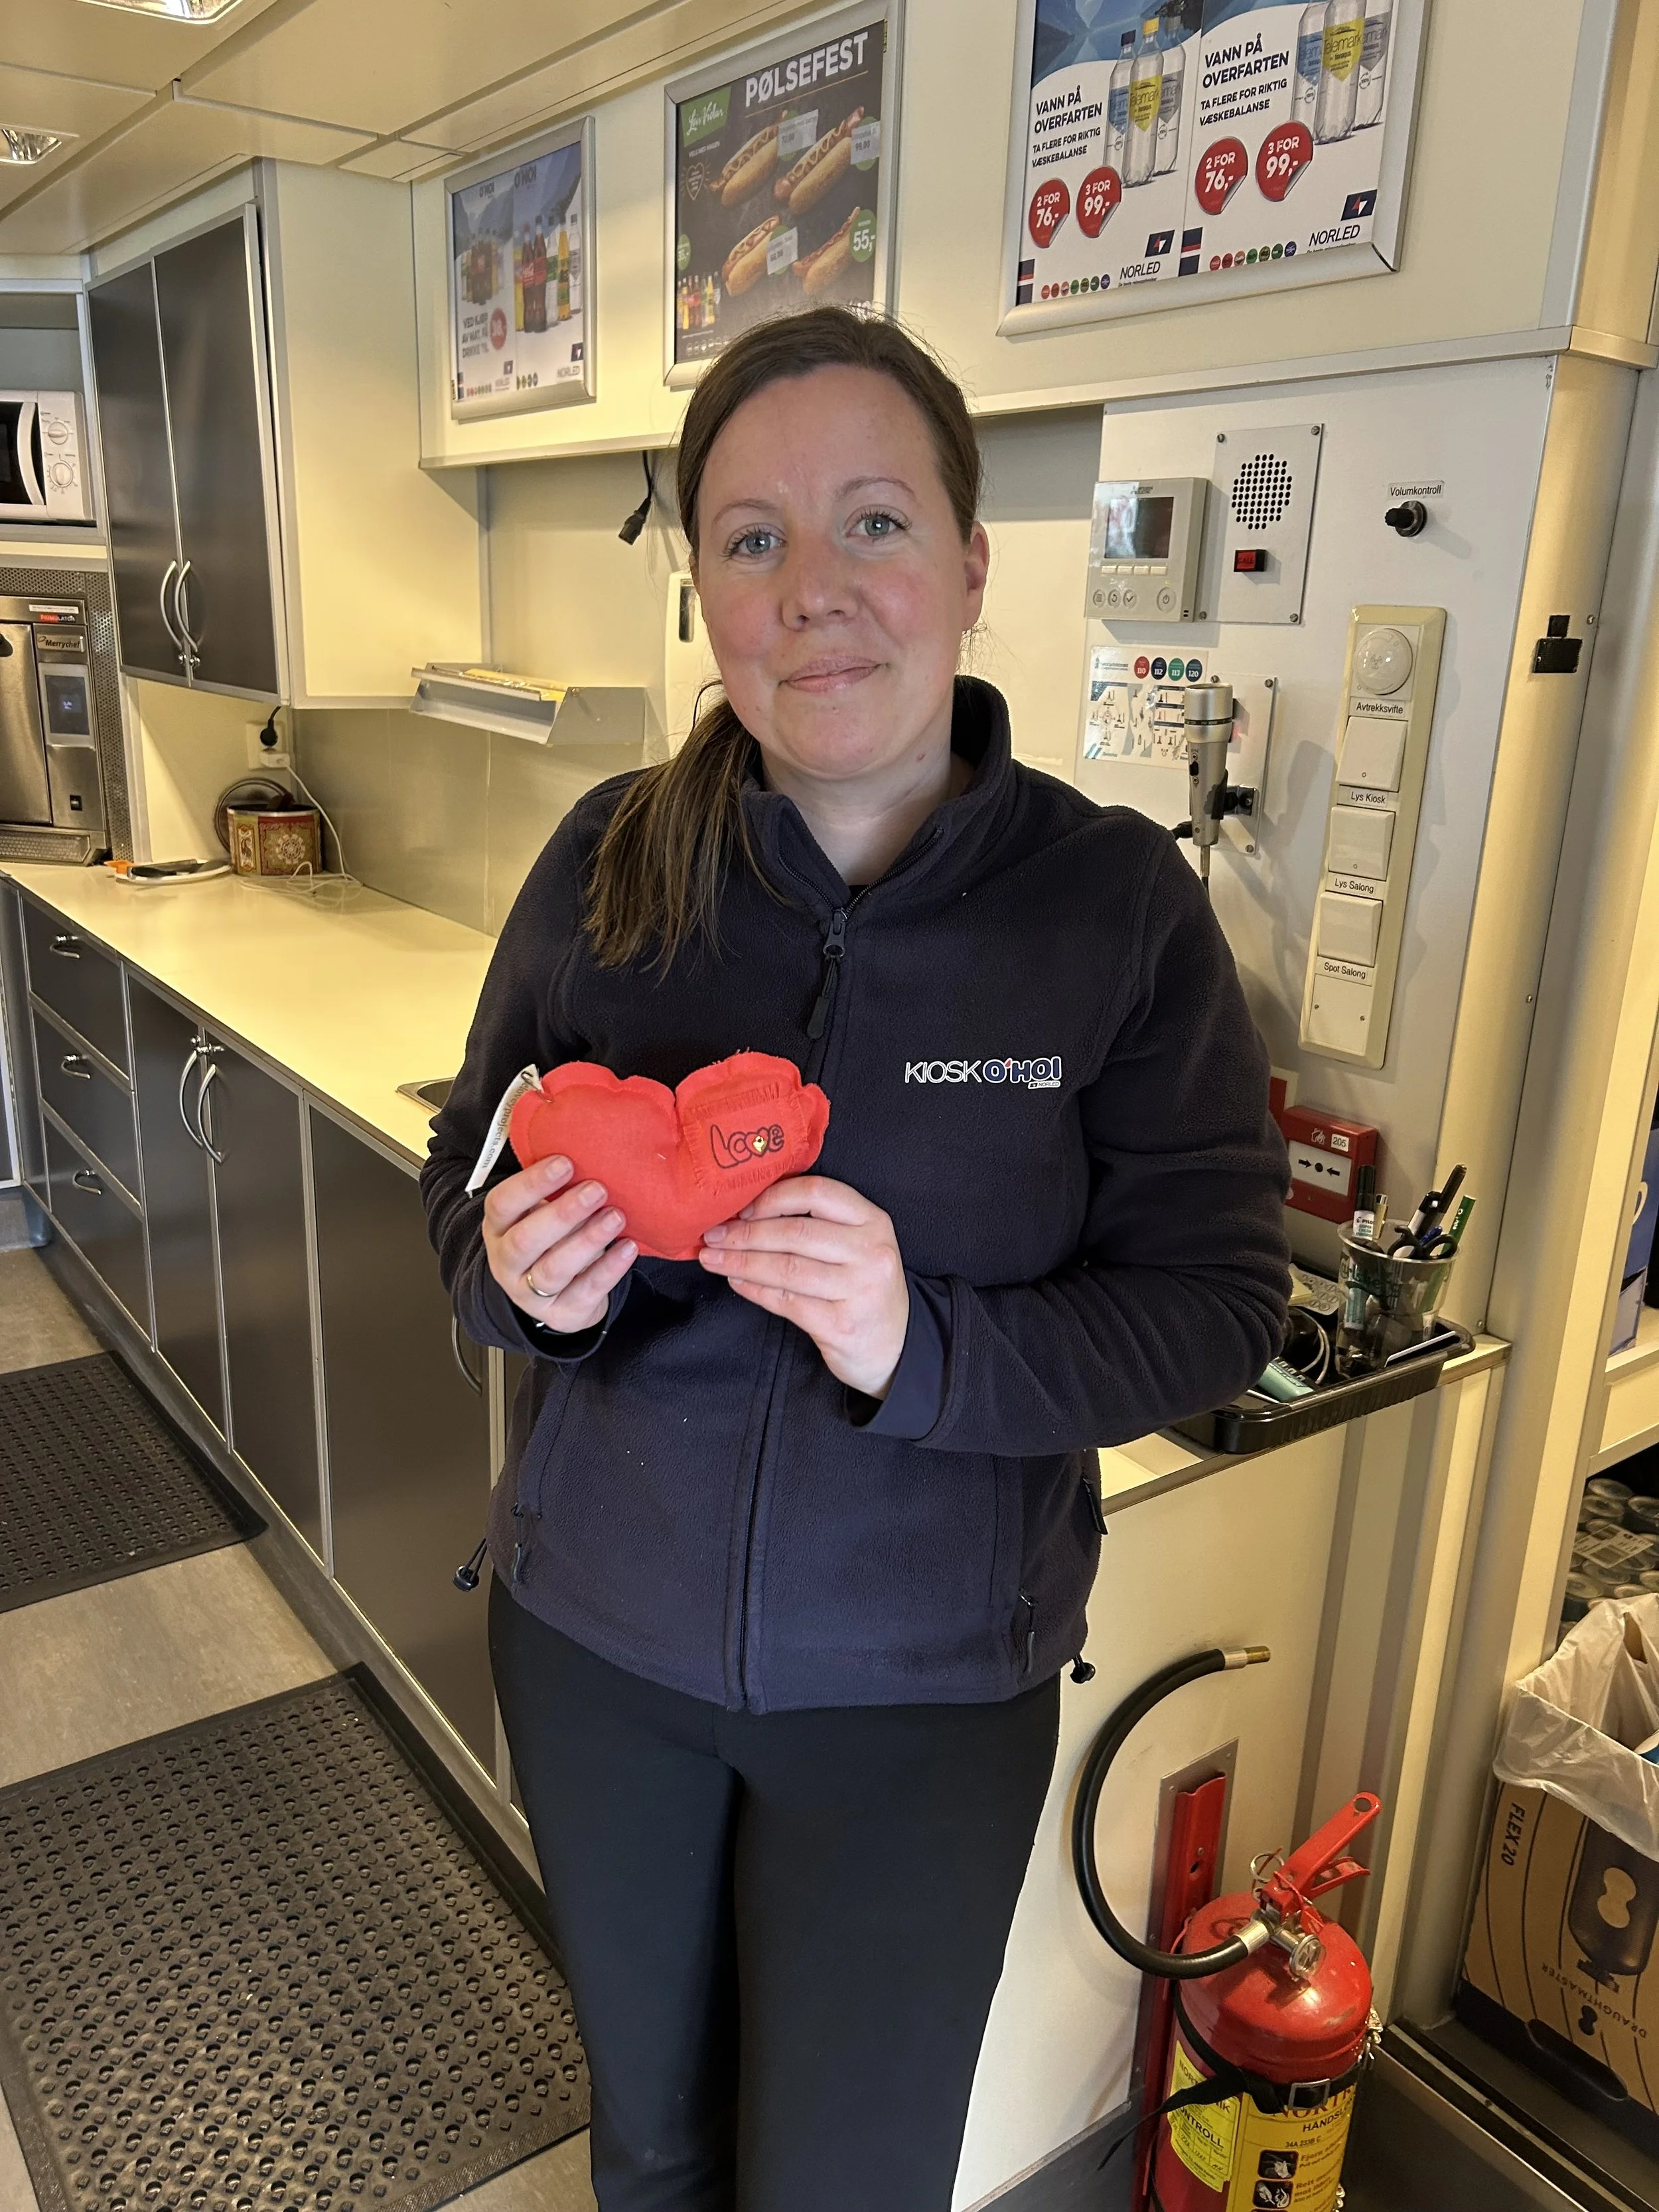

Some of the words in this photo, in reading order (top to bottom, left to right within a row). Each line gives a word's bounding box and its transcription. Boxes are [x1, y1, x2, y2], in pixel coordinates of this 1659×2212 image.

[1204, 44, 1242, 68] VANN
[1245, 33, 1263, 57] PÅ
[746, 31, 868, 108] PØLSEFEST
[1202, 50, 1289, 88] OVERFARTEN
[1036, 95, 1066, 115] VANN
[1068, 85, 1082, 106] PÅ
[1200, 99, 1210, 111] TA
[1212, 92, 1238, 108] FLERE
[1239, 88, 1256, 101] FOR
[1258, 78, 1287, 95] RIKTIG
[1034, 102, 1103, 133] OVERFARTEN
[1199, 99, 1270, 126] VÆSKEBALANSE
[1033, 144, 1041, 154] TA
[1042, 138, 1061, 152] FLERE
[1063, 133, 1076, 146] FOR
[1078, 127, 1101, 141] RIKTIG
[1267, 142, 1274, 155] 3
[1276, 136, 1300, 153] FOR
[1032, 145, 1088, 168] VÆSKEBALANSE
[1206, 157, 1212, 170] 2
[1214, 151, 1236, 168] FOR
[1266, 153, 1299, 179] 99,-
[1086, 184, 1090, 195] 3
[1092, 179, 1110, 193] FOR
[1204, 168, 1234, 192] 76,-
[1037, 196, 1042, 207] 2
[1043, 192, 1060, 205] FOR
[1084, 194, 1110, 217] 99,-
[1036, 206, 1059, 228] 76,-
[853, 229, 875, 252] 55,-
[1309, 224, 1360, 246] NORLED
[1119, 261, 1161, 279] NORLED
[1390, 484, 1441, 496] Volumkontroll
[45, 638, 80, 650] Merrychef
[1356, 702, 1404, 714] Avtrekksvifte
[1351, 792, 1364, 802] Lys
[1366, 793, 1386, 804] Kiosk
[1334, 878, 1347, 888] Lys
[1349, 881, 1374, 894] Salong
[1324, 962, 1340, 973] Spot
[1341, 966, 1366, 980] Salong
[904, 1060, 982, 1084] KIOSK
[1333, 1137, 1346, 1147] 205
[1504, 1803, 1525, 1846] FLEX
[1502, 1847, 1516, 1866] 20
[1542, 1961, 1648, 2039] DRAUGHTMASTER
[1179, 2106, 1224, 2149] ONTROLL
